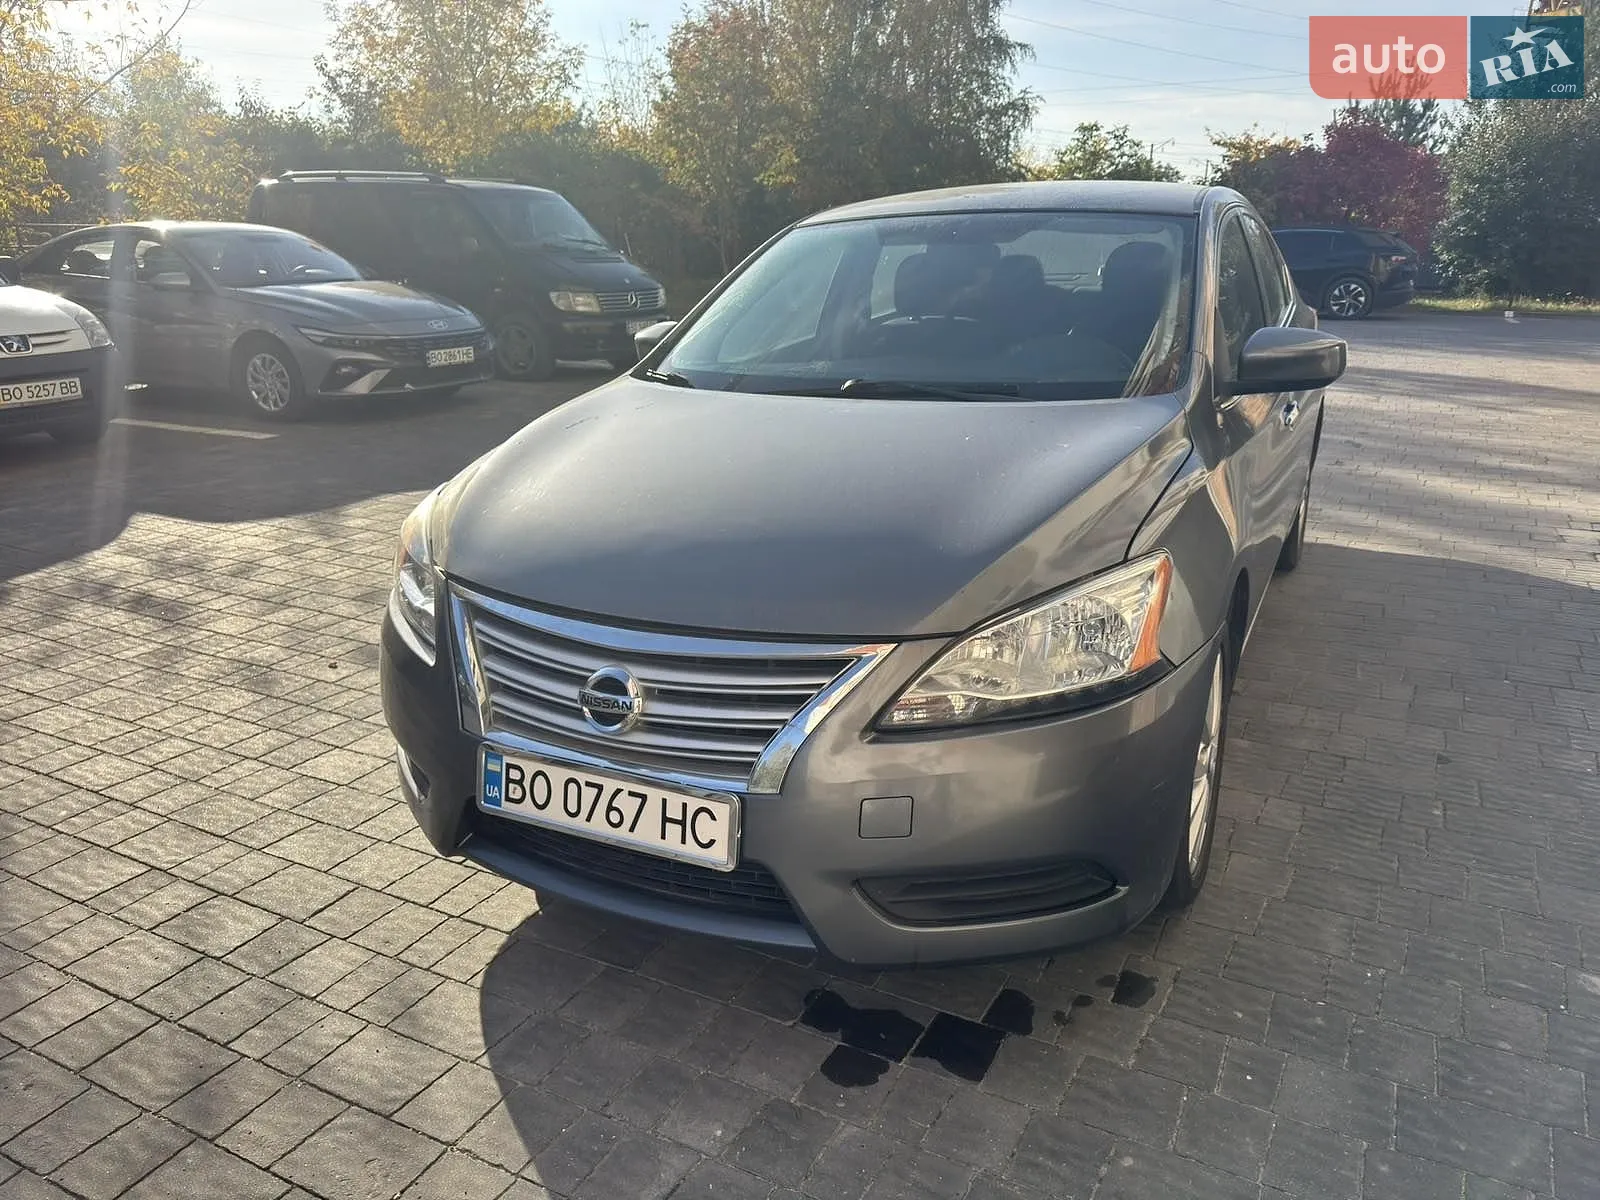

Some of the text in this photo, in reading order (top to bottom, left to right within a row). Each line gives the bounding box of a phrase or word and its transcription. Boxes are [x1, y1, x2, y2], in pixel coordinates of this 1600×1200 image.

[0, 381, 78, 401] BO 5257 BB
[581, 692, 633, 711] NISSAN
[486, 783, 500, 800] UA
[504, 762, 717, 849] BO 0767 HC
